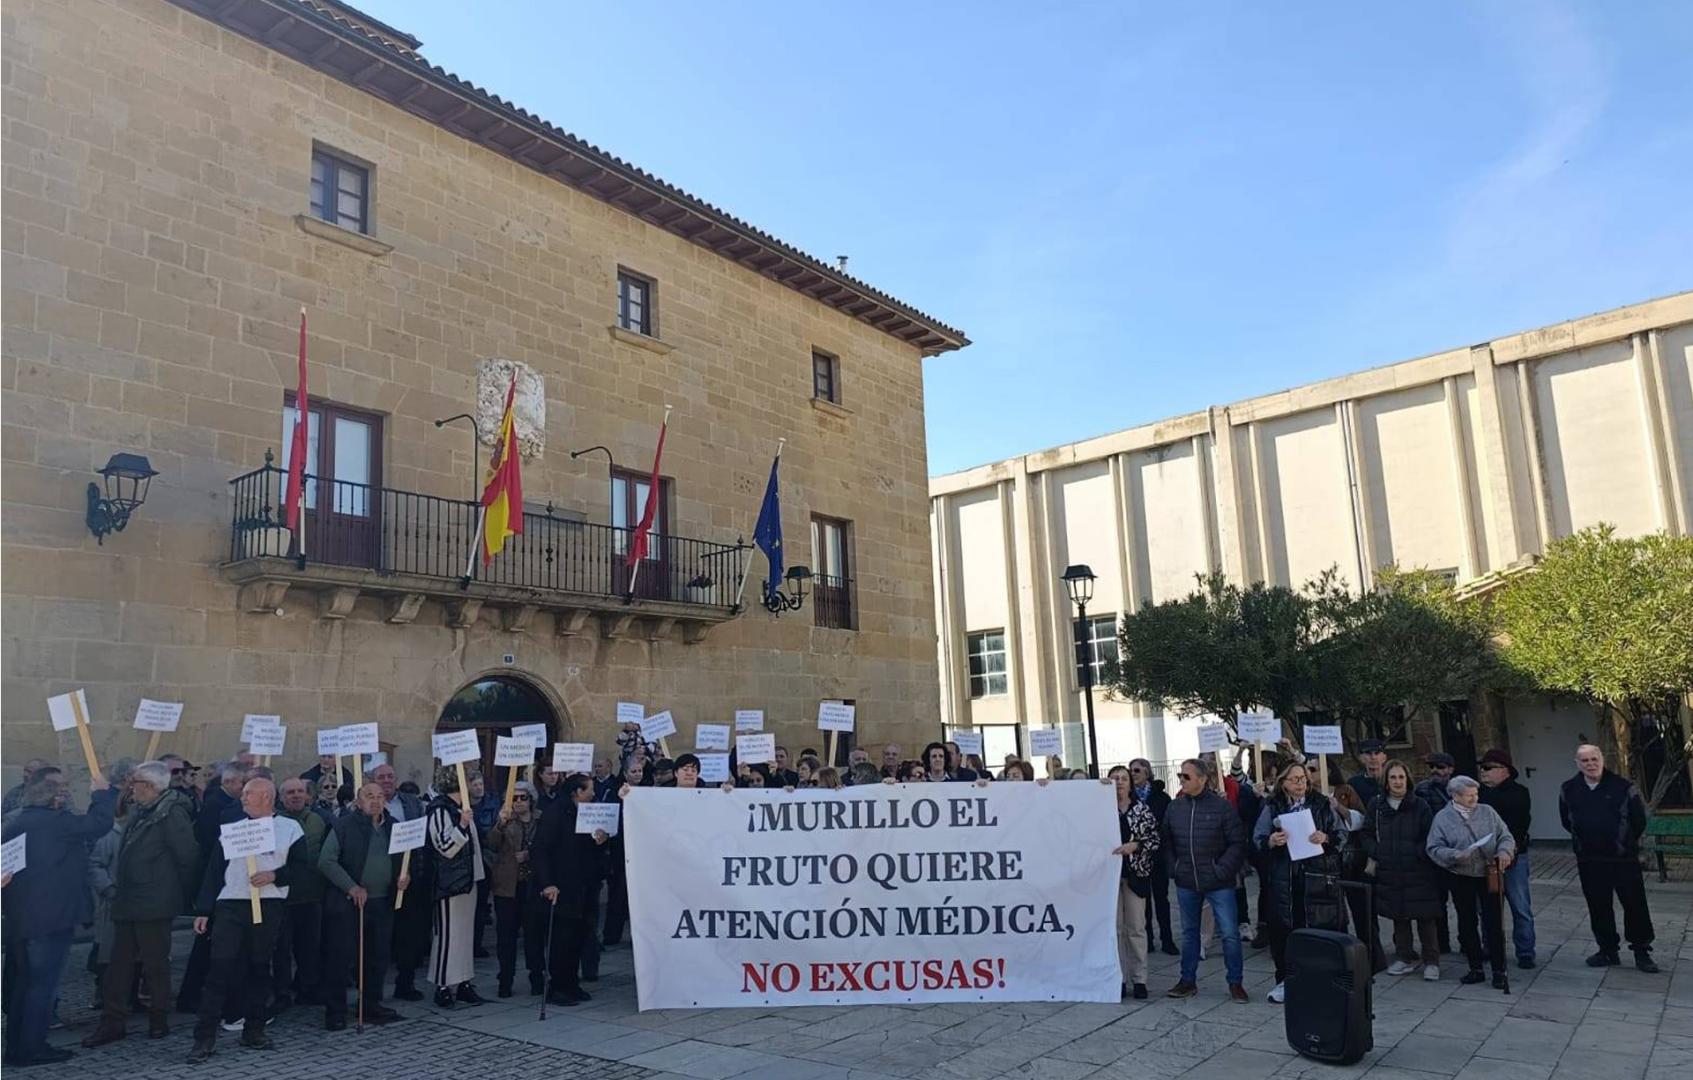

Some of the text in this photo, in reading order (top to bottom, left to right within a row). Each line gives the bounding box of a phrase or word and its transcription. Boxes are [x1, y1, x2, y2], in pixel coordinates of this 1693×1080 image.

[748, 798, 997, 832] ¡MURILLO EL
[722, 851, 1022, 890] FRUTO QUIERE
[671, 896, 1074, 941] ATENCIÓN MÉDICA,
[741, 958, 1005, 992] NO EXCUSAS!
